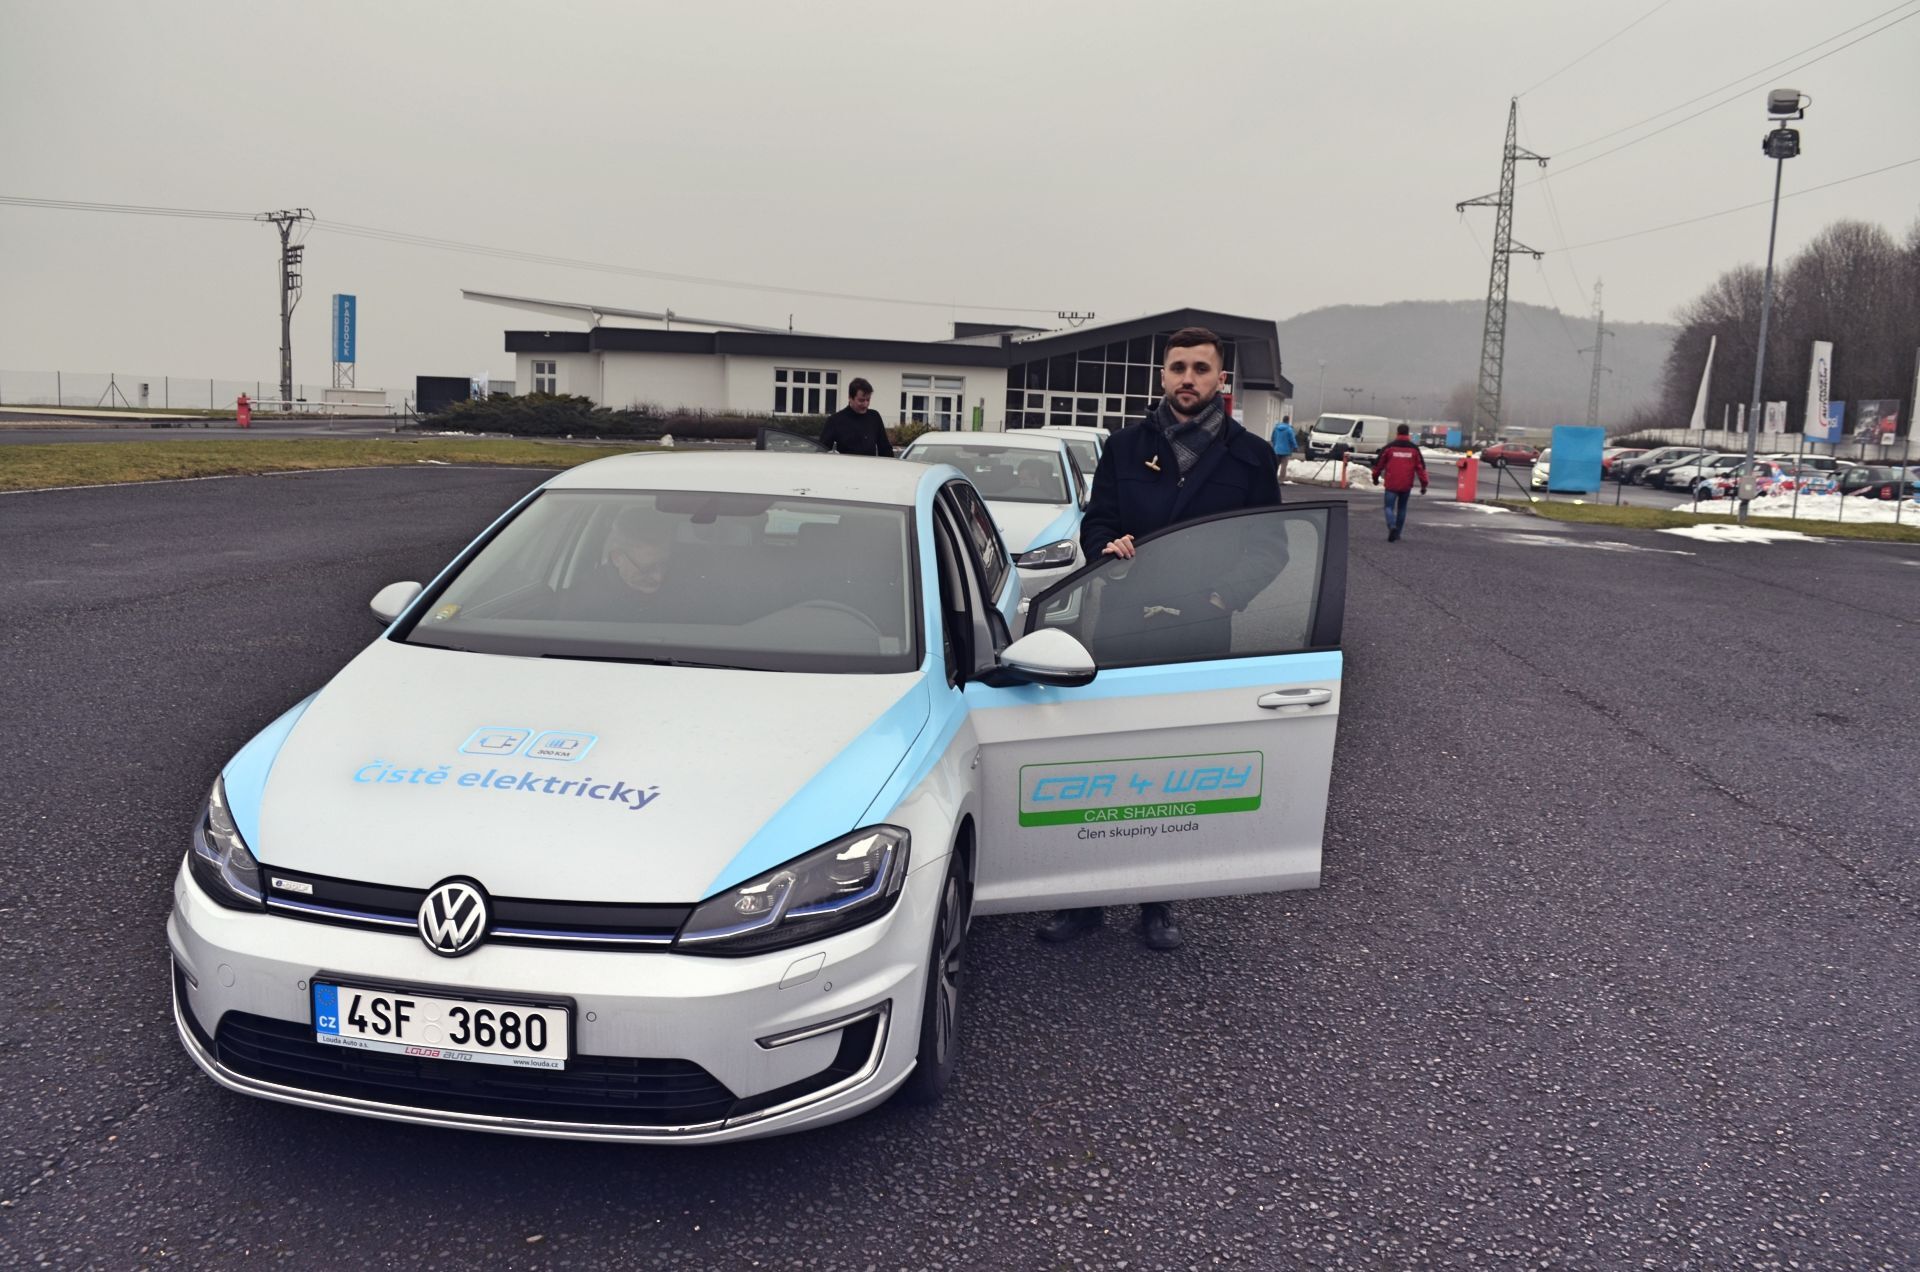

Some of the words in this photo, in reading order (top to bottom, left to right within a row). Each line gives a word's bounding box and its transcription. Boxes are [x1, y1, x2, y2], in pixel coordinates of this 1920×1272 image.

[353, 759, 451, 785] Čistě
[457, 769, 661, 811] elektrický
[1129, 773, 1153, 796] 4
[1084, 808, 1119, 823] CAR
[1124, 803, 1196, 820] SHARING
[1077, 827, 1106, 840] Člen
[1109, 824, 1158, 839] skupiny
[1161, 821, 1199, 833] Louda
[319, 1015, 337, 1029] CZ
[347, 994, 415, 1037] 4SF
[449, 1006, 547, 1051] 3680
[322, 1036, 341, 1044] Louda
[342, 1039, 358, 1047] Auto
[513, 1058, 559, 1068] www.louda.cz
